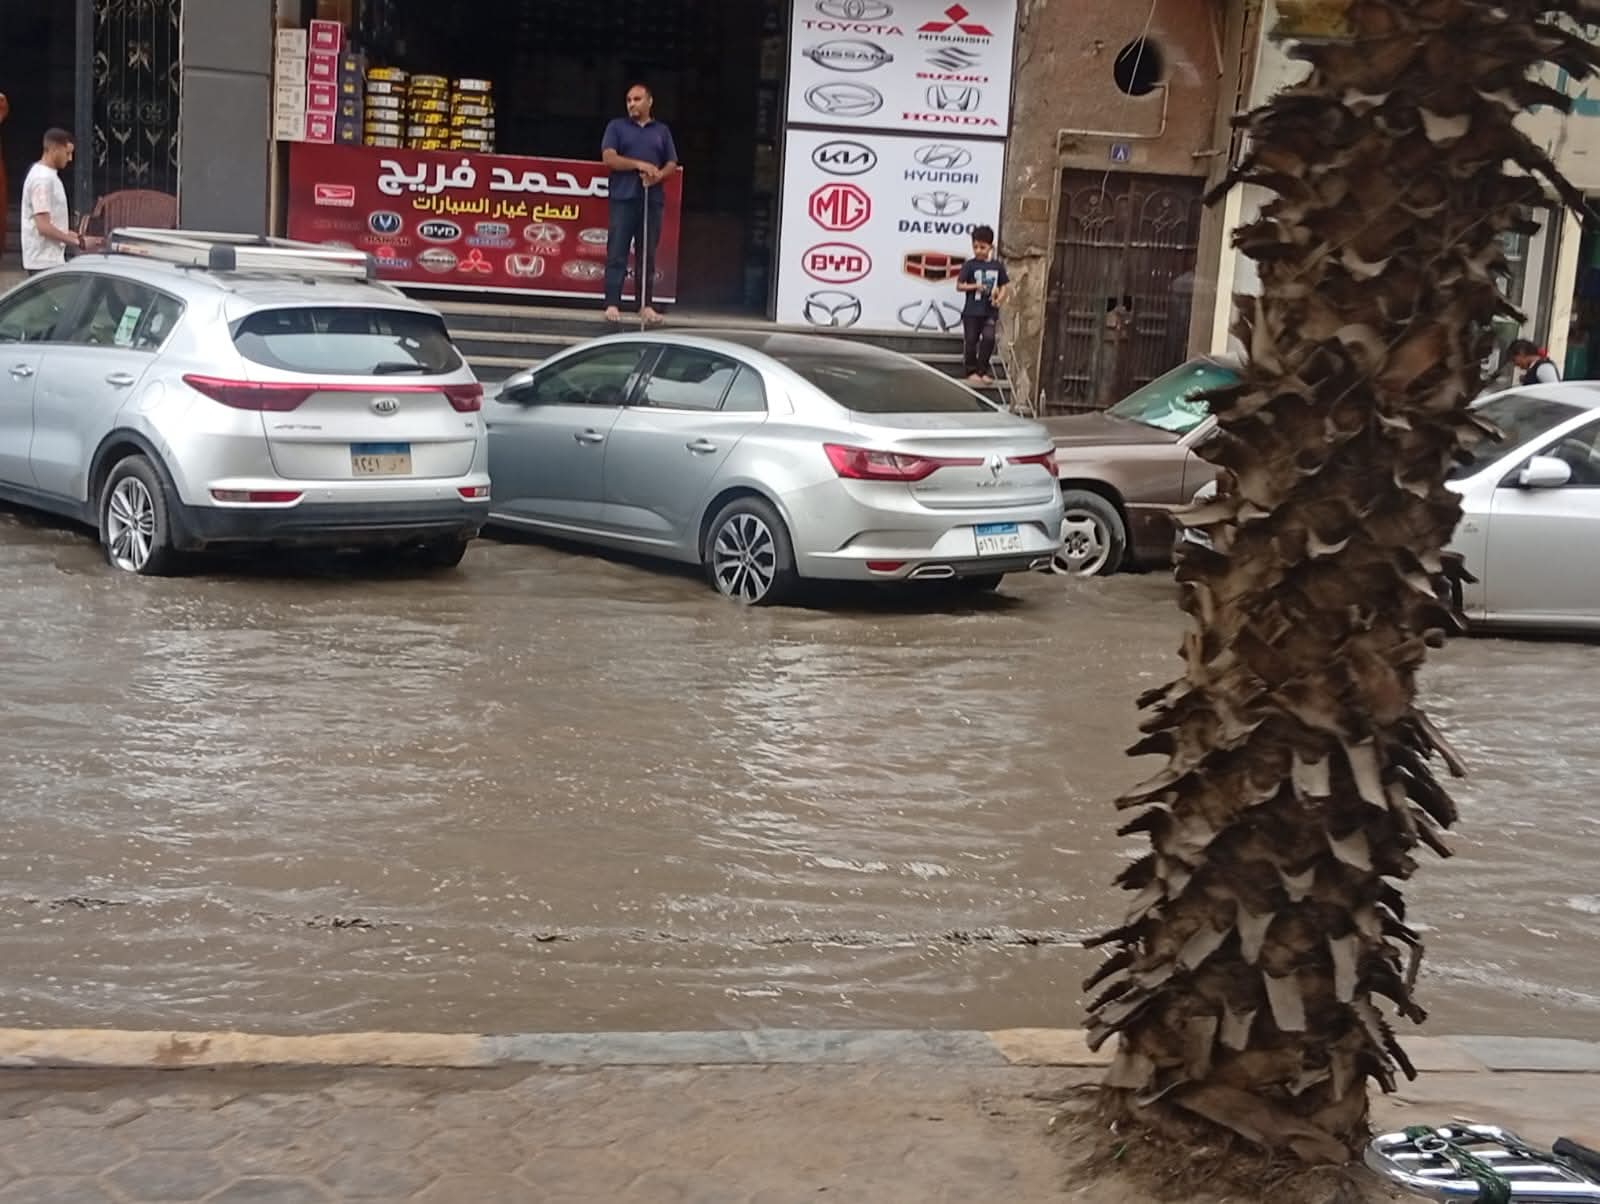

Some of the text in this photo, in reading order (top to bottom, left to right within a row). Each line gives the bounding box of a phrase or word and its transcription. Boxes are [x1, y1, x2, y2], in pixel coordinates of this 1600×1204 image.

[802, 20, 904, 36] TOYOTA
[918, 34, 990, 45] MITSUBISHI
[813, 49, 886, 62] NISSAN
[915, 72, 989, 83] SUZUKI
[901, 112, 999, 126] HONDA
[820, 150, 869, 164] KIA
[377, 158, 609, 198] محمد فريج
[904, 169, 979, 185] HYUNDAI
[412, 195, 580, 223] لقطع غيار السيارات
[816, 188, 864, 226] MG
[423, 226, 455, 237] BYD
[810, 254, 863, 272] BYD
